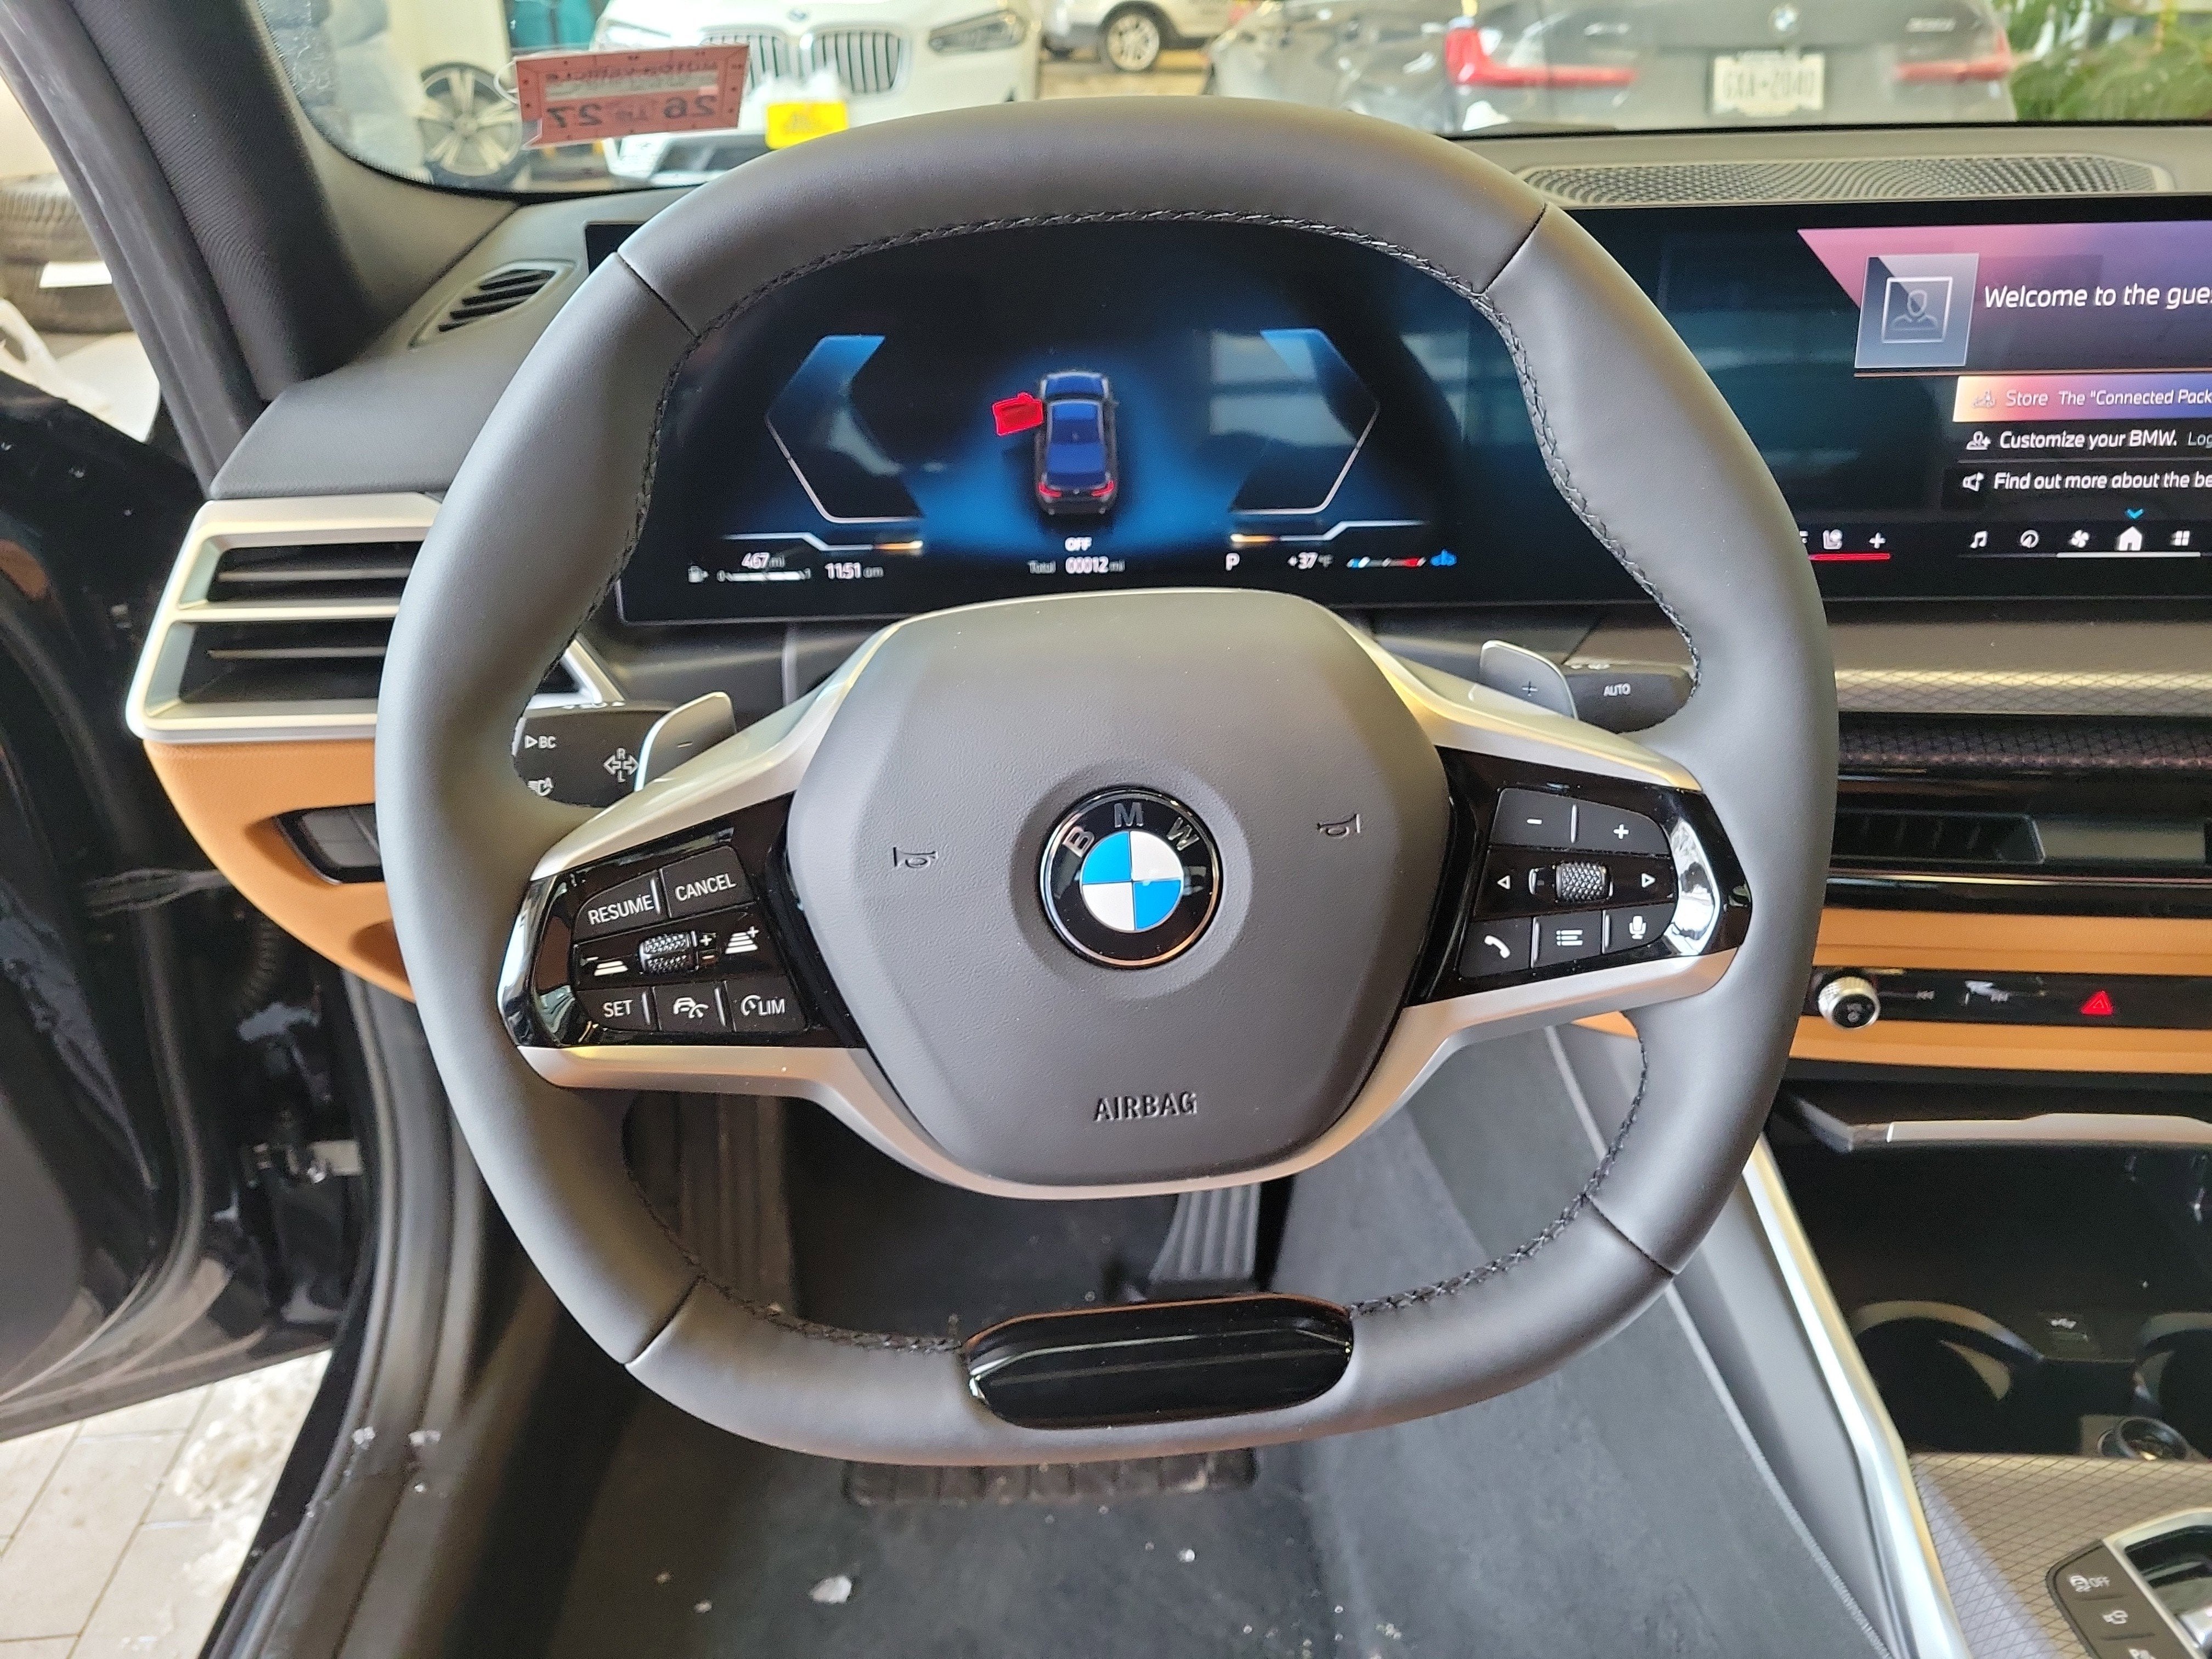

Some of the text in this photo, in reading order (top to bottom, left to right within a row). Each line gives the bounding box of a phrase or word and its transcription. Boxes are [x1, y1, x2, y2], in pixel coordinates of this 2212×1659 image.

[1985, 283, 2212, 309] Welcome to the gue
[2006, 389, 2049, 406] Store
[2059, 388, 2212, 405] The "Connected Pack
[2000, 430, 2085, 449] Customize
[2088, 433, 2125, 450] your
[2129, 429, 2177, 447] BMW.
[1994, 472, 2030, 490] Find
[2034, 473, 2062, 489] out
[2064, 475, 2107, 489] more
[2112, 472, 2159, 489] about
[2163, 471, 2190, 488] the
[741, 552, 770, 568] 467
[1226, 552, 1240, 571] P
[1603, 683, 1631, 697] AUTO
[538, 736, 557, 749] BC
[617, 748, 626, 760] R
[1063, 802, 1200, 858] BMW
[675, 873, 736, 902] CANCEL
[588, 893, 656, 926] RESUME
[603, 999, 633, 1019] SET
[758, 997, 786, 1016] LIM
[1093, 1091, 1198, 1122] AIRBAG
